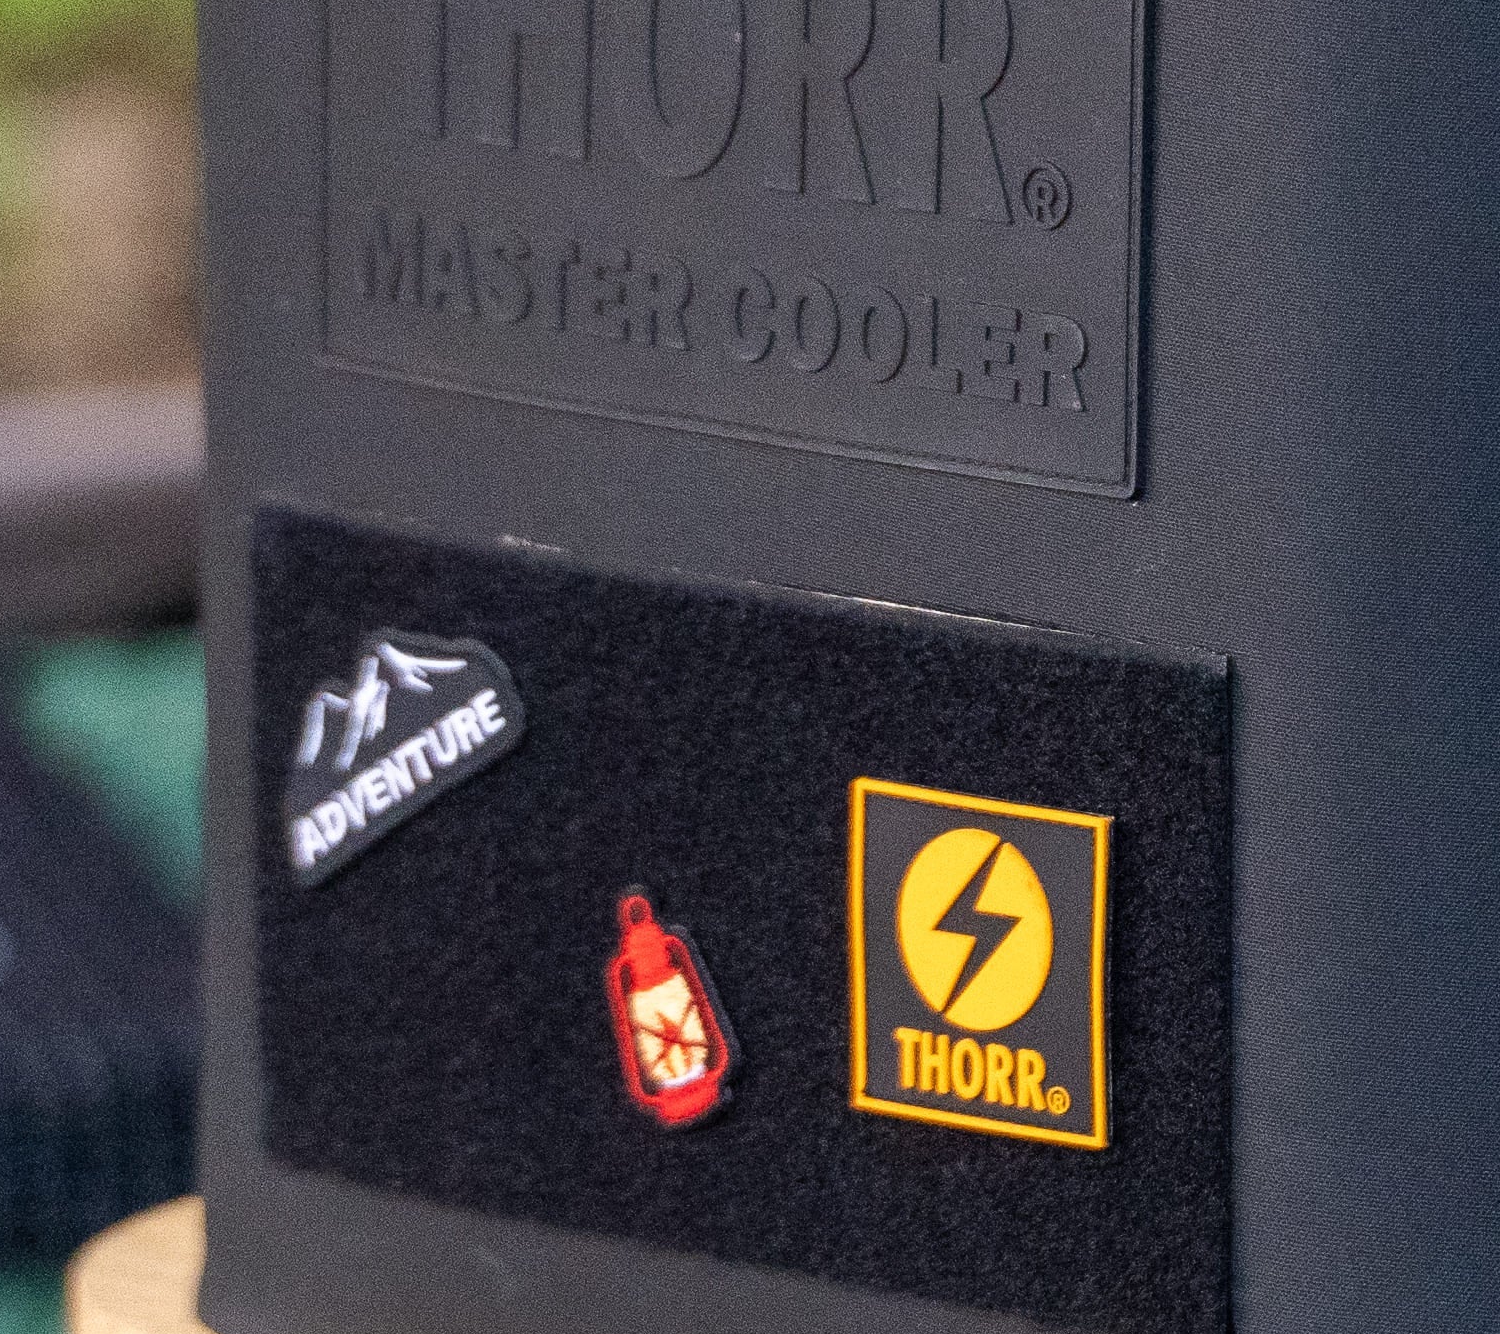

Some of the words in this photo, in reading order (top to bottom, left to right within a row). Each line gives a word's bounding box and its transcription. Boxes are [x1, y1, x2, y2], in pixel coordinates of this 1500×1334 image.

[355, 207, 695, 352] MASTER
[720, 266, 1091, 412] COOLER
[292, 687, 506, 867] ADVENTURE
